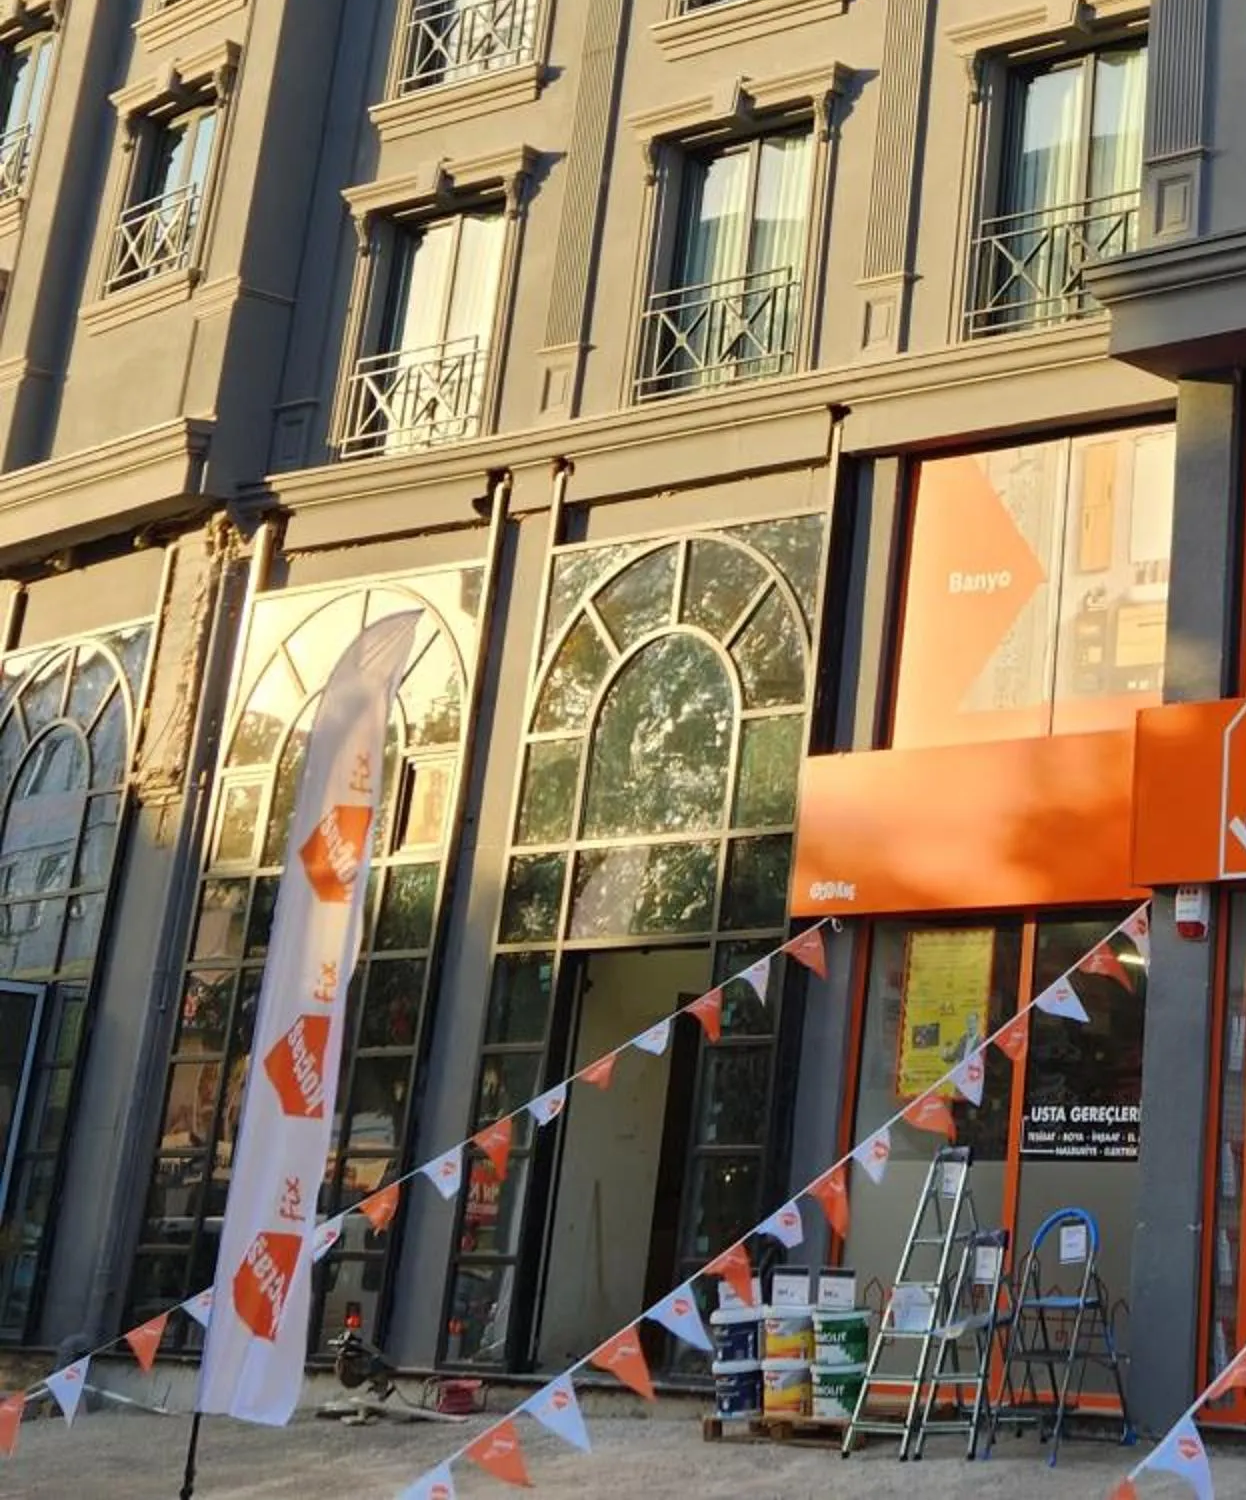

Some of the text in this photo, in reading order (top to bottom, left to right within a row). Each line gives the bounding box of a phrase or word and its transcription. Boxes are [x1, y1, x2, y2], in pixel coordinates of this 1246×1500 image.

[948, 568, 1012, 594] Banyo
[314, 961, 338, 1004] fix
[1031, 1104, 1067, 1122] USTA
[280, 1176, 306, 1222] fix
